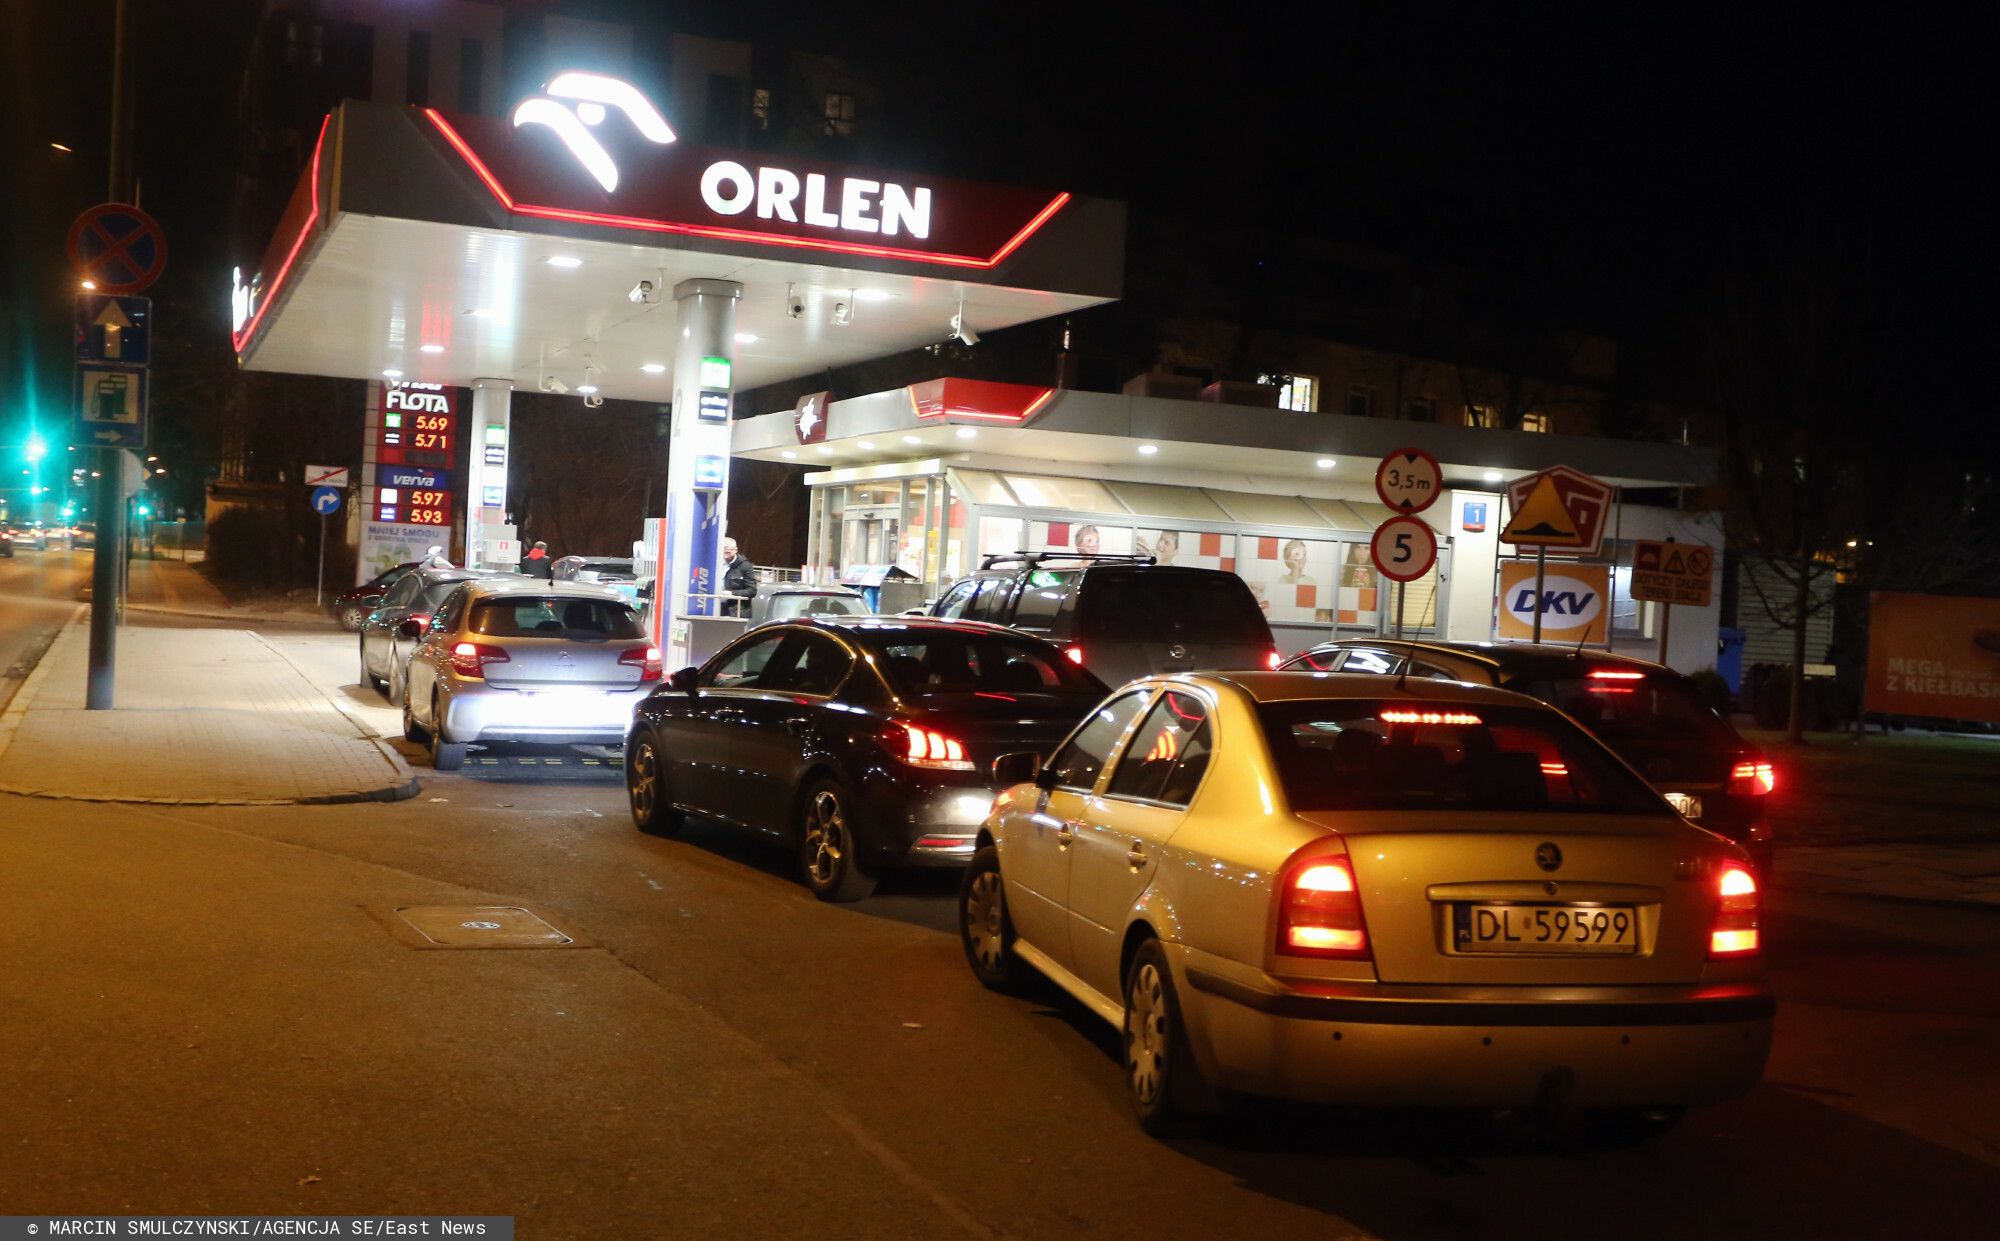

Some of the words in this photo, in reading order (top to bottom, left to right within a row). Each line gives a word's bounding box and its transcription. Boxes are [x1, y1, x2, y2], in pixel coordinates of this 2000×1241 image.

[701, 160, 931, 239] ORLEN
[386, 391, 449, 413] FLOTA
[416, 415, 448, 431] 5.69
[415, 433, 447, 449] 5.71
[393, 474, 435, 487] verva
[411, 491, 443, 506] 5.97
[410, 509, 443, 523] 5.93
[1474, 508, 1480, 523] 1
[1393, 533, 1412, 563] 5
[1513, 589, 1595, 615] DKV
[1887, 657, 1945, 677] MEGA
[1886, 675, 1898, 692] Z
[1478, 910, 1521, 941] DL
[1536, 910, 1628, 943] 59599
